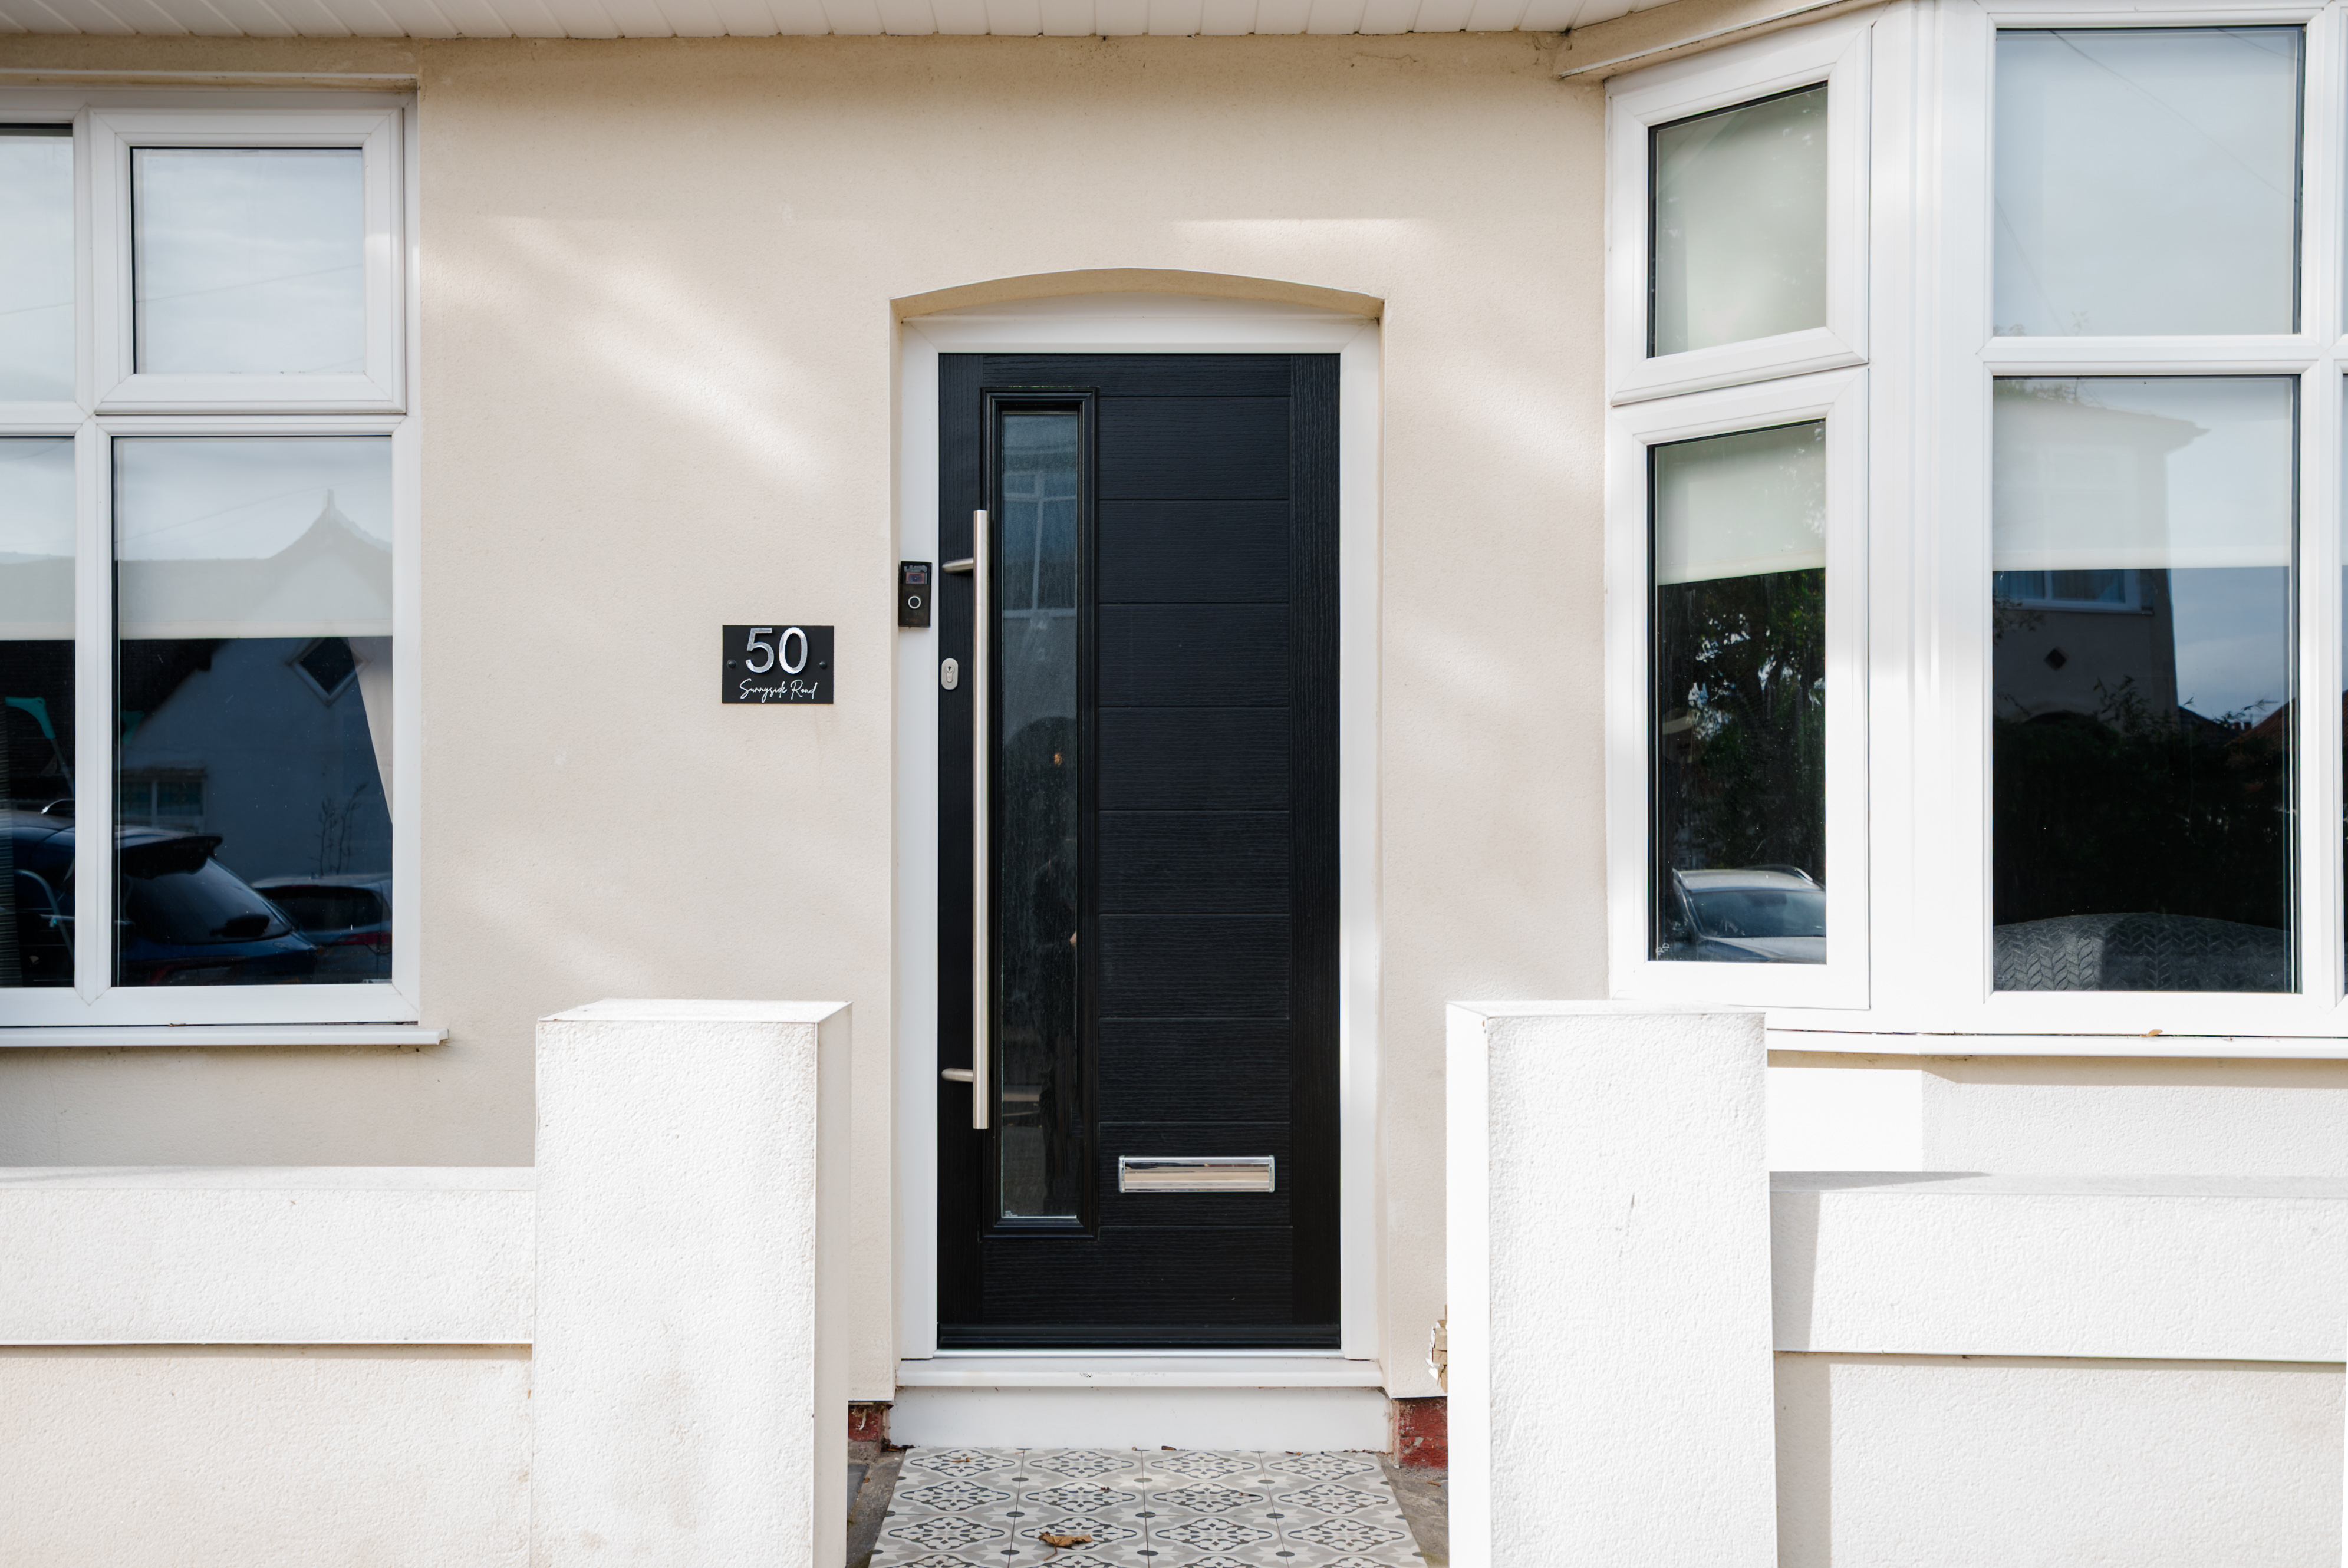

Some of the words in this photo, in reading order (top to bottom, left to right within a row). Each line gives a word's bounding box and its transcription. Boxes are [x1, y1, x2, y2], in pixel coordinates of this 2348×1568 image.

[745, 627, 808, 674] 50
[739, 678, 788, 703] Sunnyside
[790, 679, 818, 700] Road
